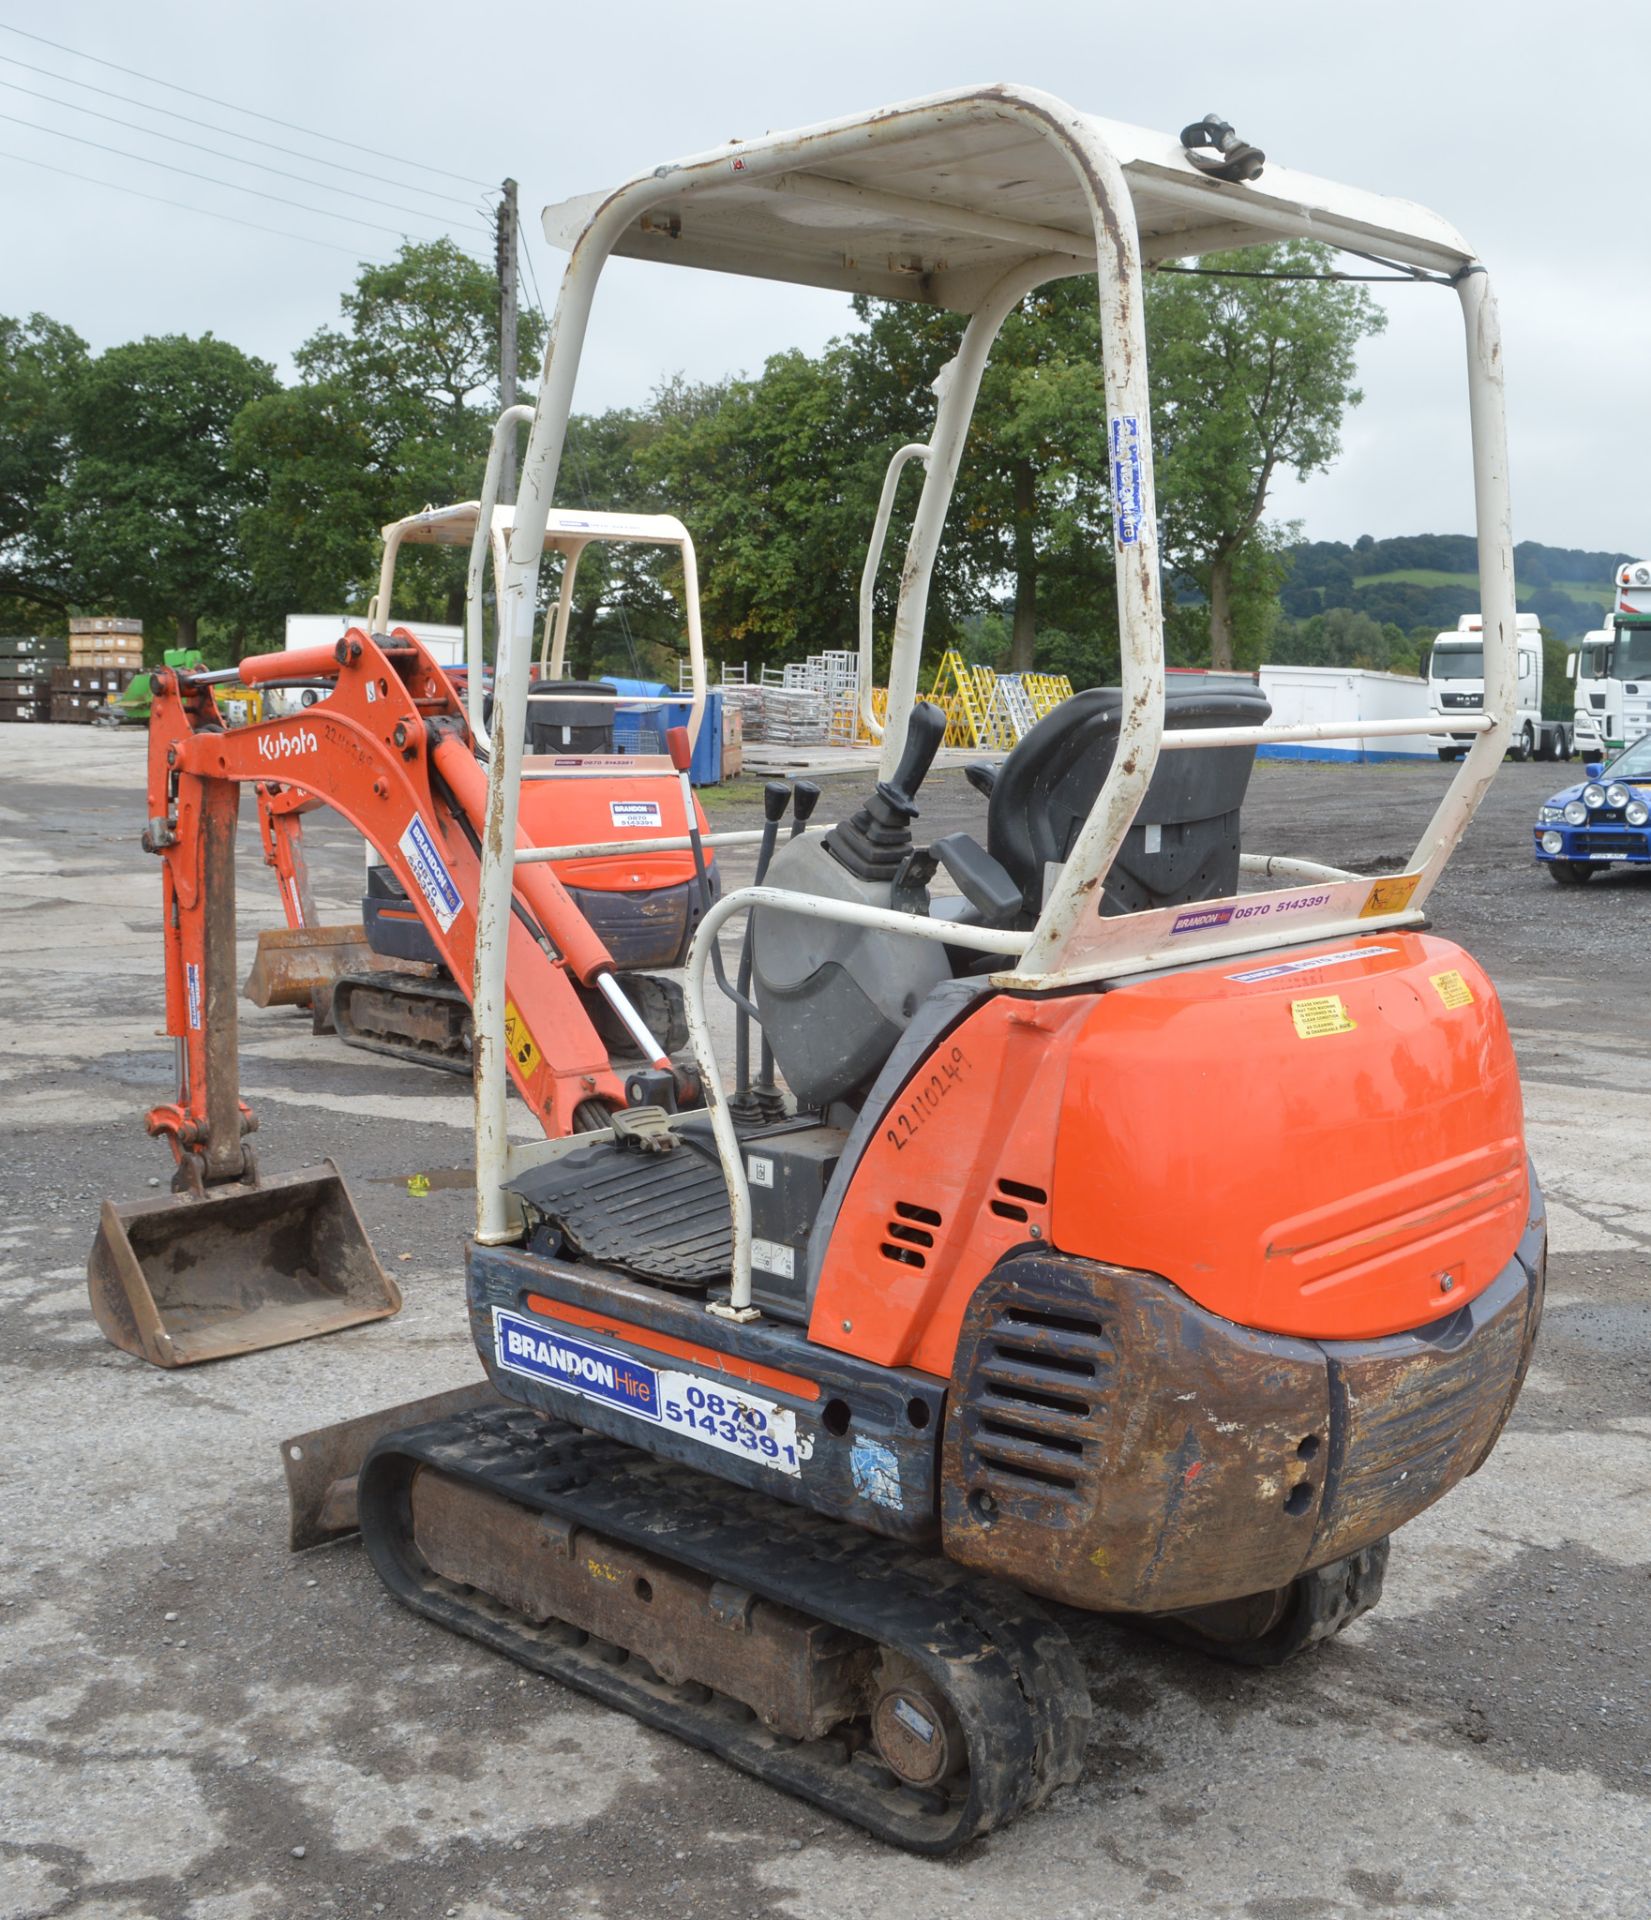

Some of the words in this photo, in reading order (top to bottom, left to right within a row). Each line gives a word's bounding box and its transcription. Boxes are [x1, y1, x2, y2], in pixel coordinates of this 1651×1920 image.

[258, 728, 317, 760] Kubota
[417, 860, 438, 898] 0870
[1235, 904, 1271, 919] 0870
[1275, 895, 1331, 913] 5143391
[887, 1047, 973, 1151] 22110249
[686, 1386, 767, 1431] 0870
[665, 1400, 796, 1465] 5143391
